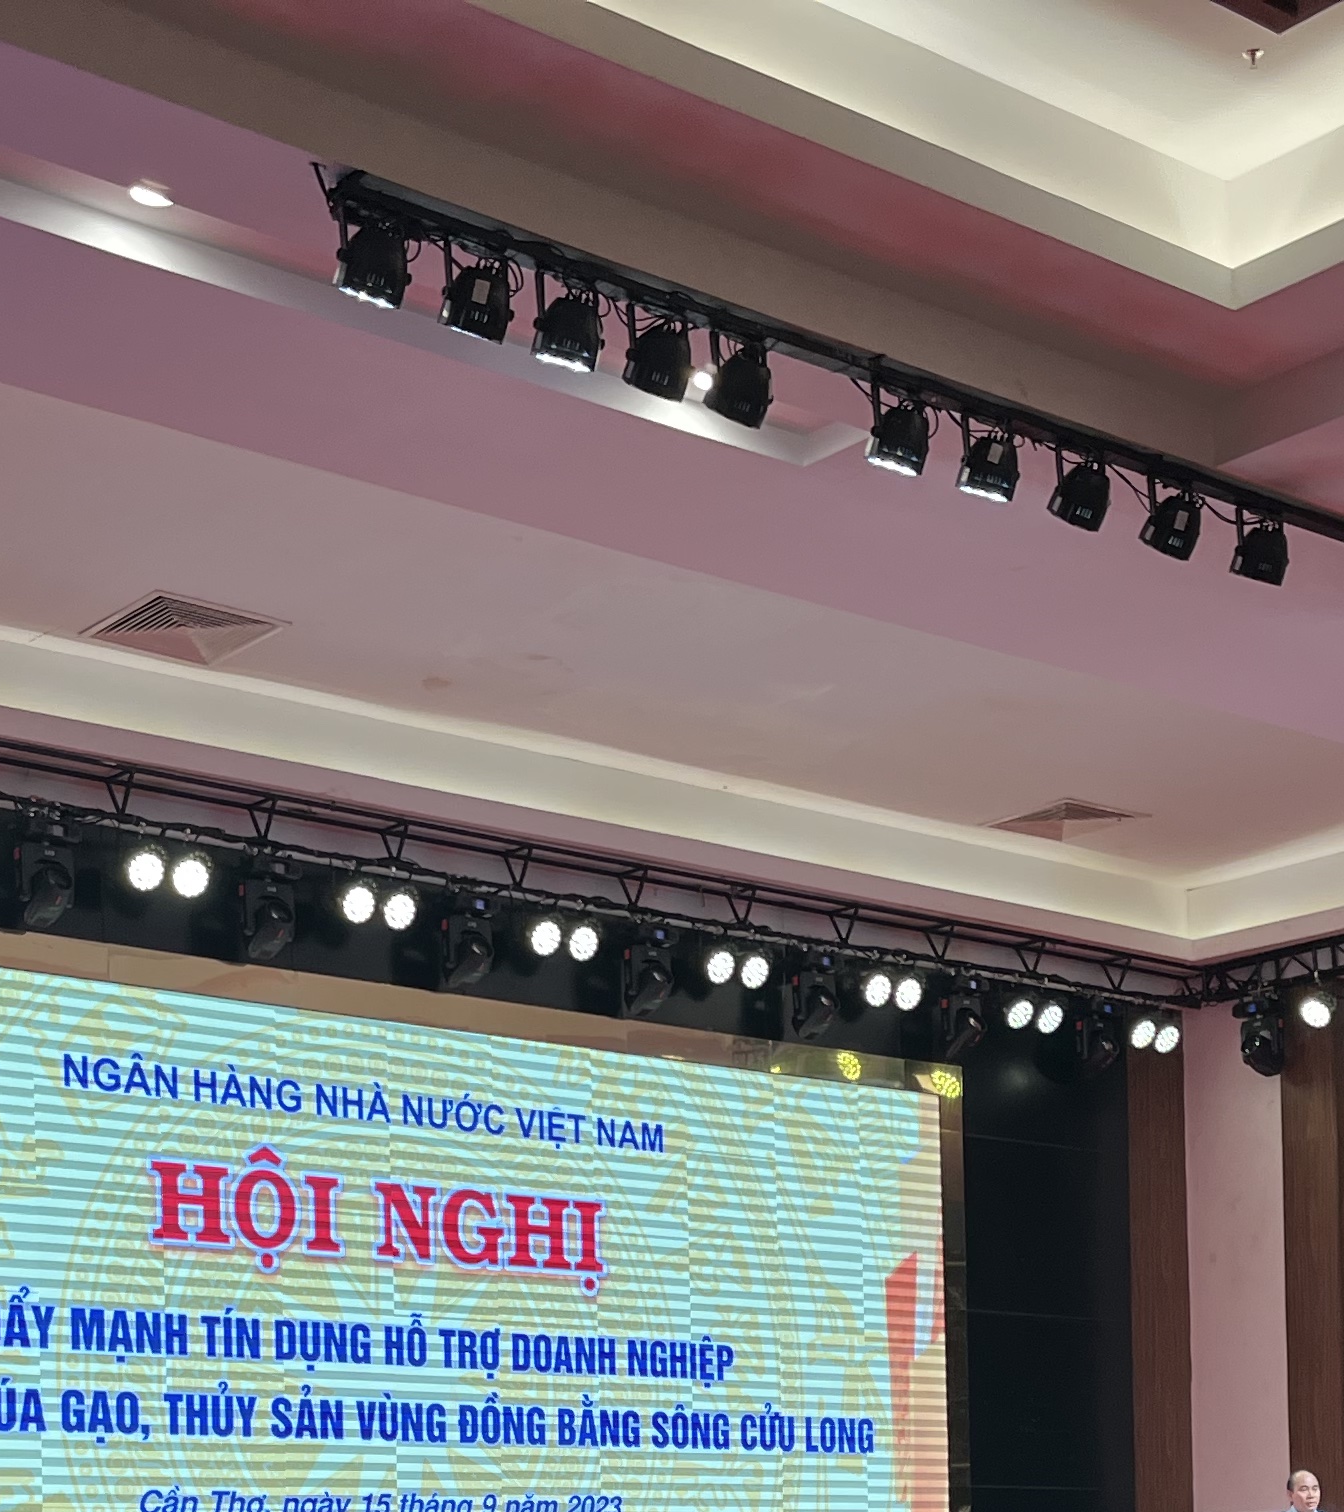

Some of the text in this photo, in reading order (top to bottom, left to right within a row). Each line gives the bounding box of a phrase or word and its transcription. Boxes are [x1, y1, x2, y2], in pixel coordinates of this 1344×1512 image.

[63, 1052, 664, 1153] NGÂN HÀNG NHÀ NƯỚC VIỆT NAM
[152, 1148, 603, 1290] HỘI NGHỊ
[70, 1307, 189, 1363] MẠNH
[200, 1307, 261, 1360] TÍN
[274, 1319, 372, 1372] DỤNG
[384, 1313, 427, 1367] HỖ
[438, 1328, 501, 1380] TRỢ
[511, 1333, 617, 1376] DOANH
[627, 1335, 734, 1389] NGHIỆP
[61, 1389, 150, 1444] GẠO,
[163, 1381, 257, 1437] THỦY
[270, 1384, 344, 1440] SẢN
[356, 1392, 447, 1443] VÙNG
[457, 1392, 546, 1446] ĐỒNG
[557, 1394, 641, 1448] BẰNG
[651, 1403, 730, 1450] SÔNG
[740, 1402, 795, 1453] CỬU
[805, 1416, 874, 1454] LONG
